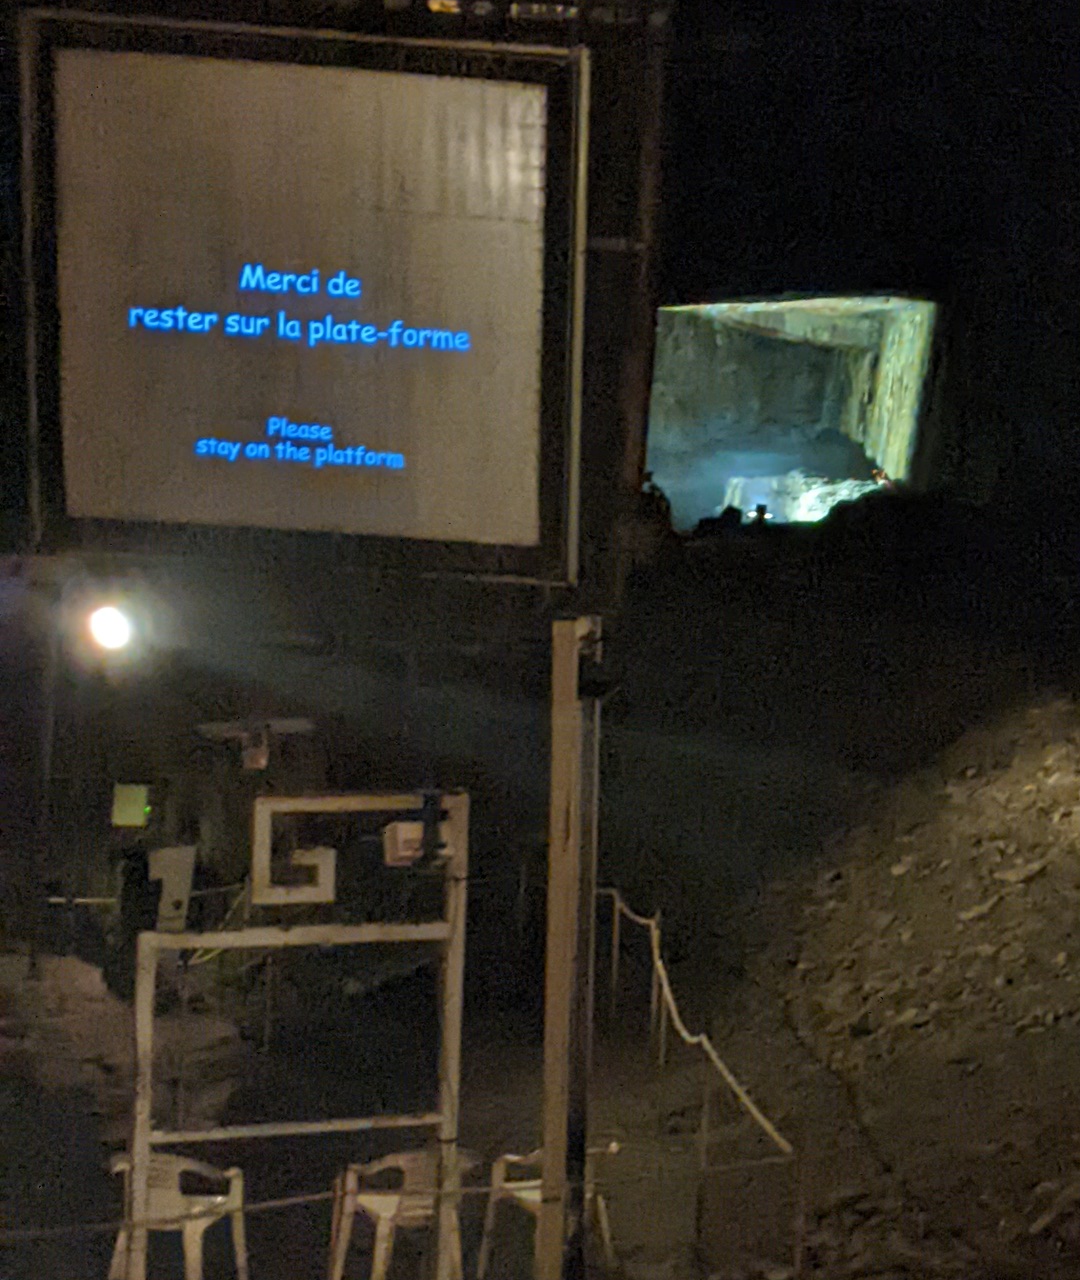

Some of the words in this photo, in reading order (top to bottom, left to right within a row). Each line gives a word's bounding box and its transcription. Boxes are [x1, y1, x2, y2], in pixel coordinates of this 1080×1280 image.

[239, 263, 320, 296] Merci
[326, 270, 362, 298] de
[129, 306, 219, 332] rester
[224, 313, 270, 337] sur
[277, 310, 302, 340] la
[308, 314, 471, 351] plate-forme
[266, 417, 333, 441] Please
[195, 438, 241, 462] stay
[244, 442, 271, 459] on
[274, 441, 310, 462] the
[314, 444, 404, 469] platform
